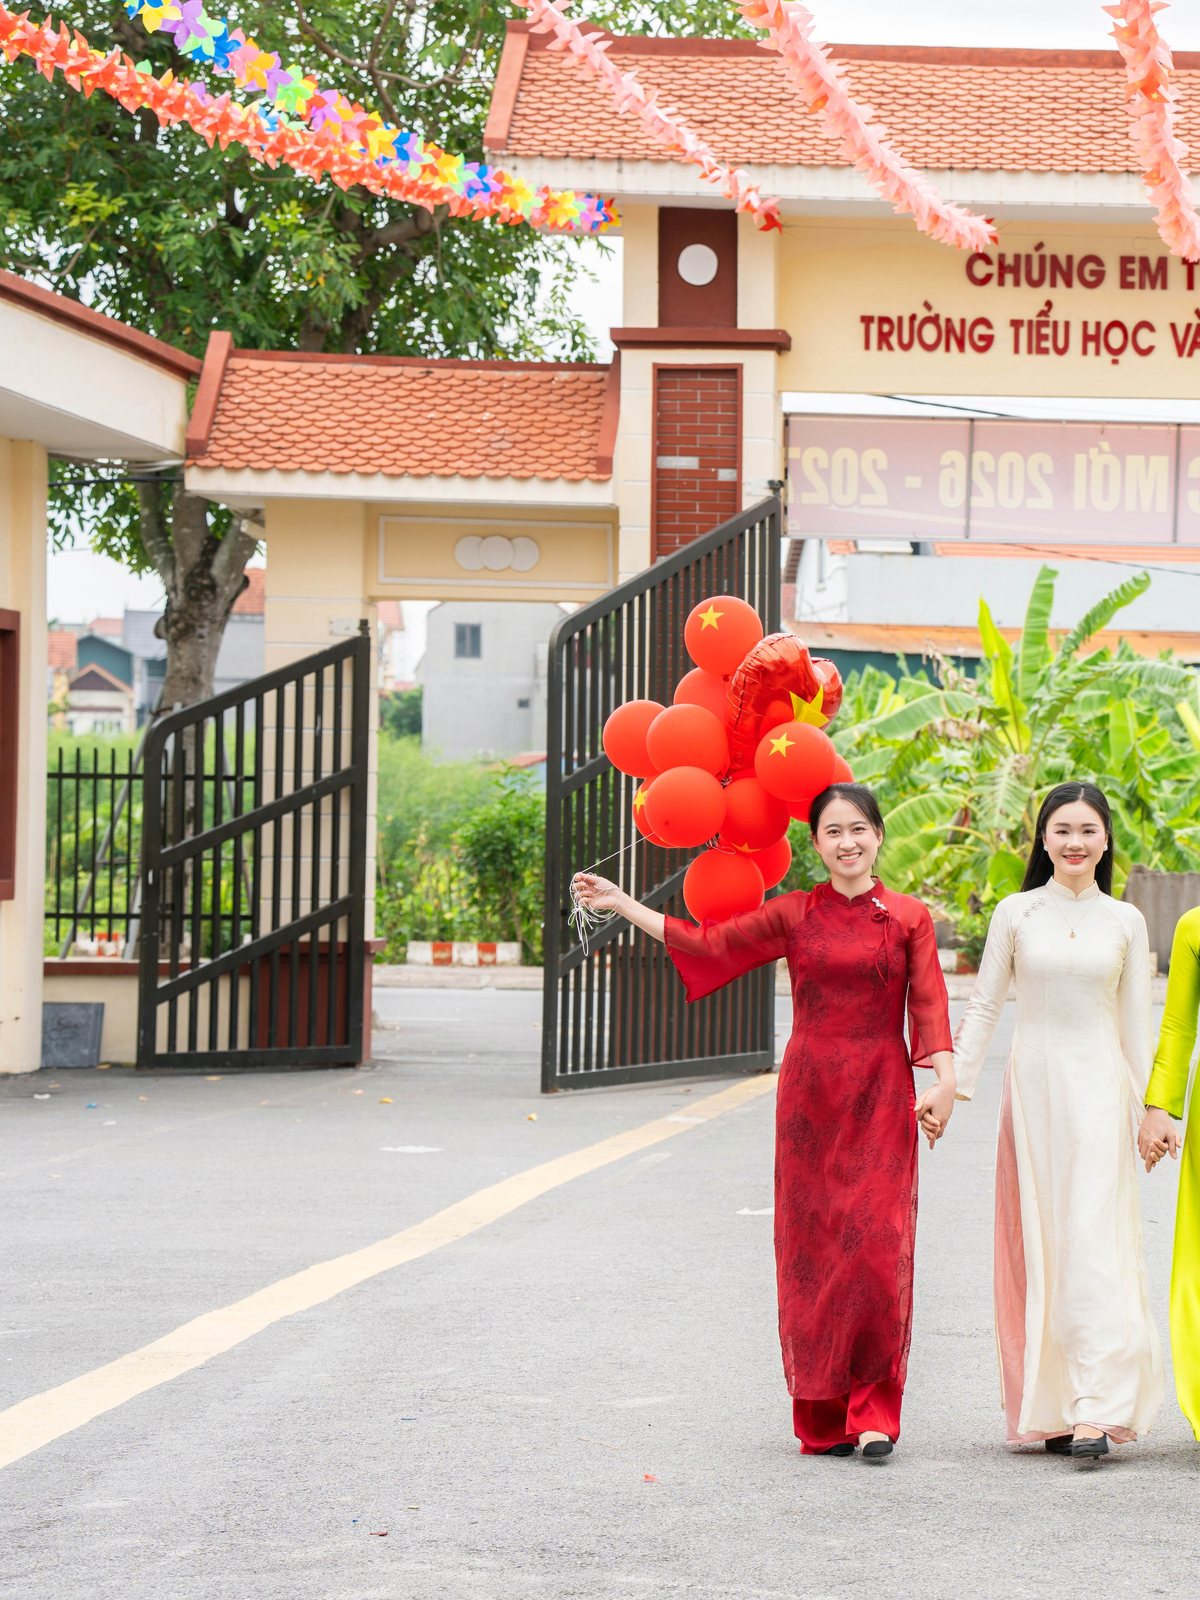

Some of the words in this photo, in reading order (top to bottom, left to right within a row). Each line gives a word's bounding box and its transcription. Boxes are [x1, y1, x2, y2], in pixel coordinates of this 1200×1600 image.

[966, 242, 1105, 290] CHÚNG
[1120, 256, 1168, 290] EM
[861, 300, 995, 353] TRƯỜNG
[1010, 300, 1070, 355] TIỂU
[1082, 320, 1156, 365] HỌC
